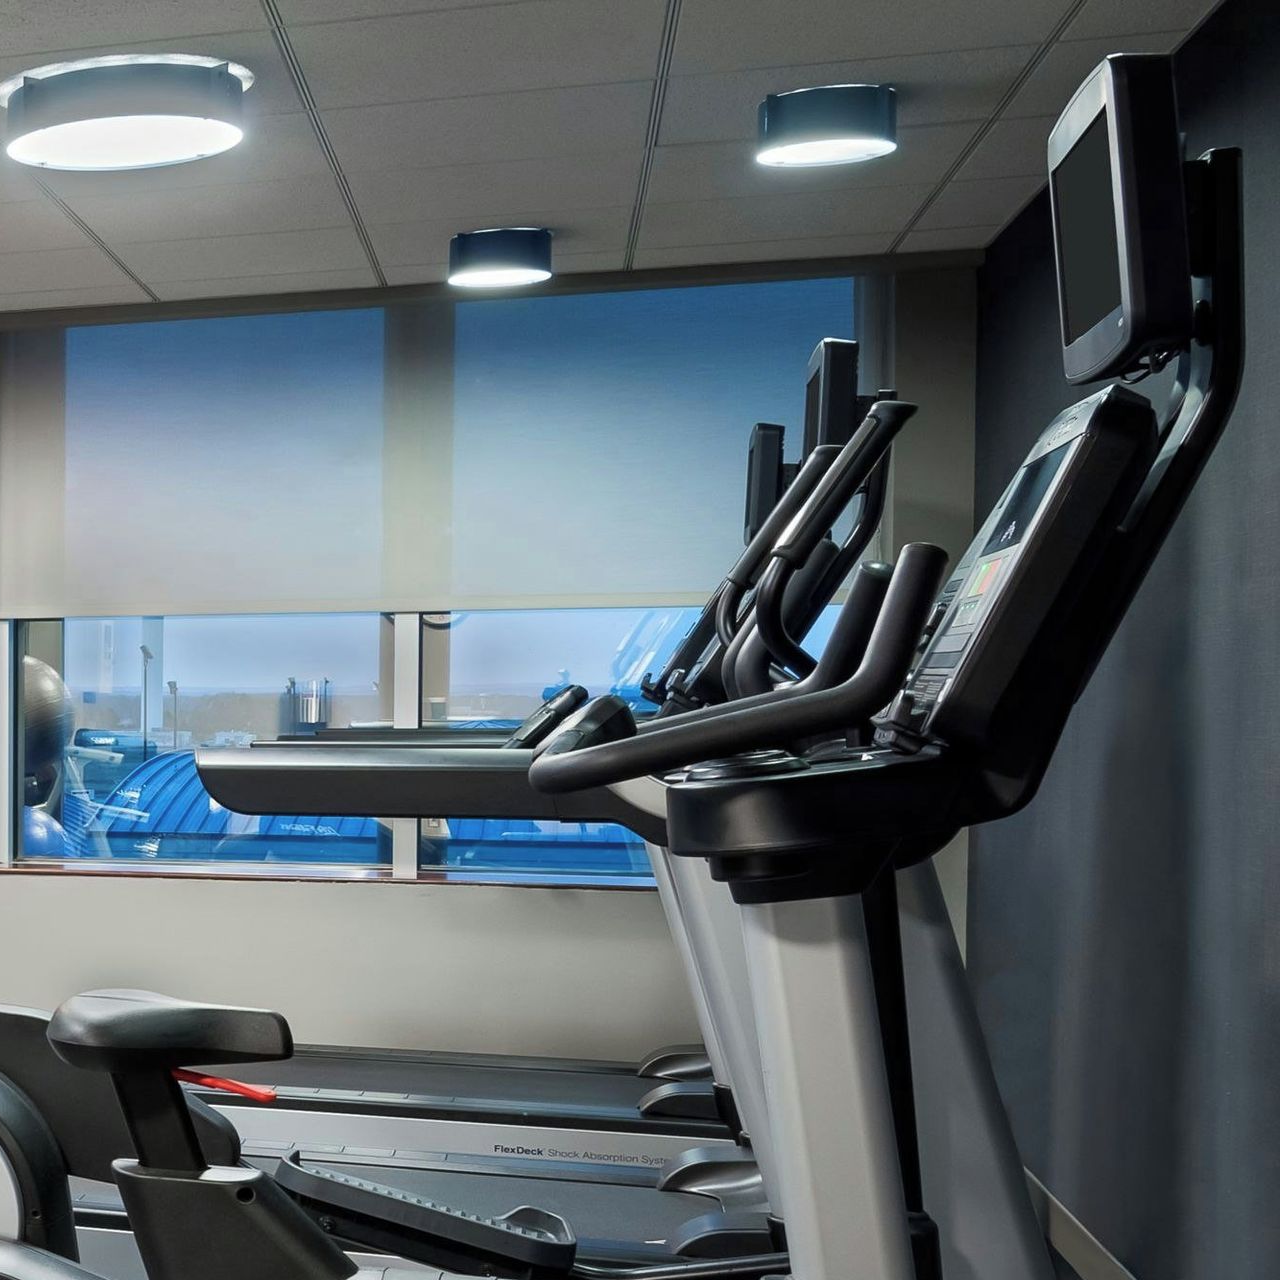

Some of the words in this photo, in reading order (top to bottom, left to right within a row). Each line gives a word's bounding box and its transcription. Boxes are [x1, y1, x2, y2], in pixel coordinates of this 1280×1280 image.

[493, 1144, 543, 1156] FlexDeck
[548, 1148, 580, 1159] Shock
[582, 1151, 639, 1165] Absorption
